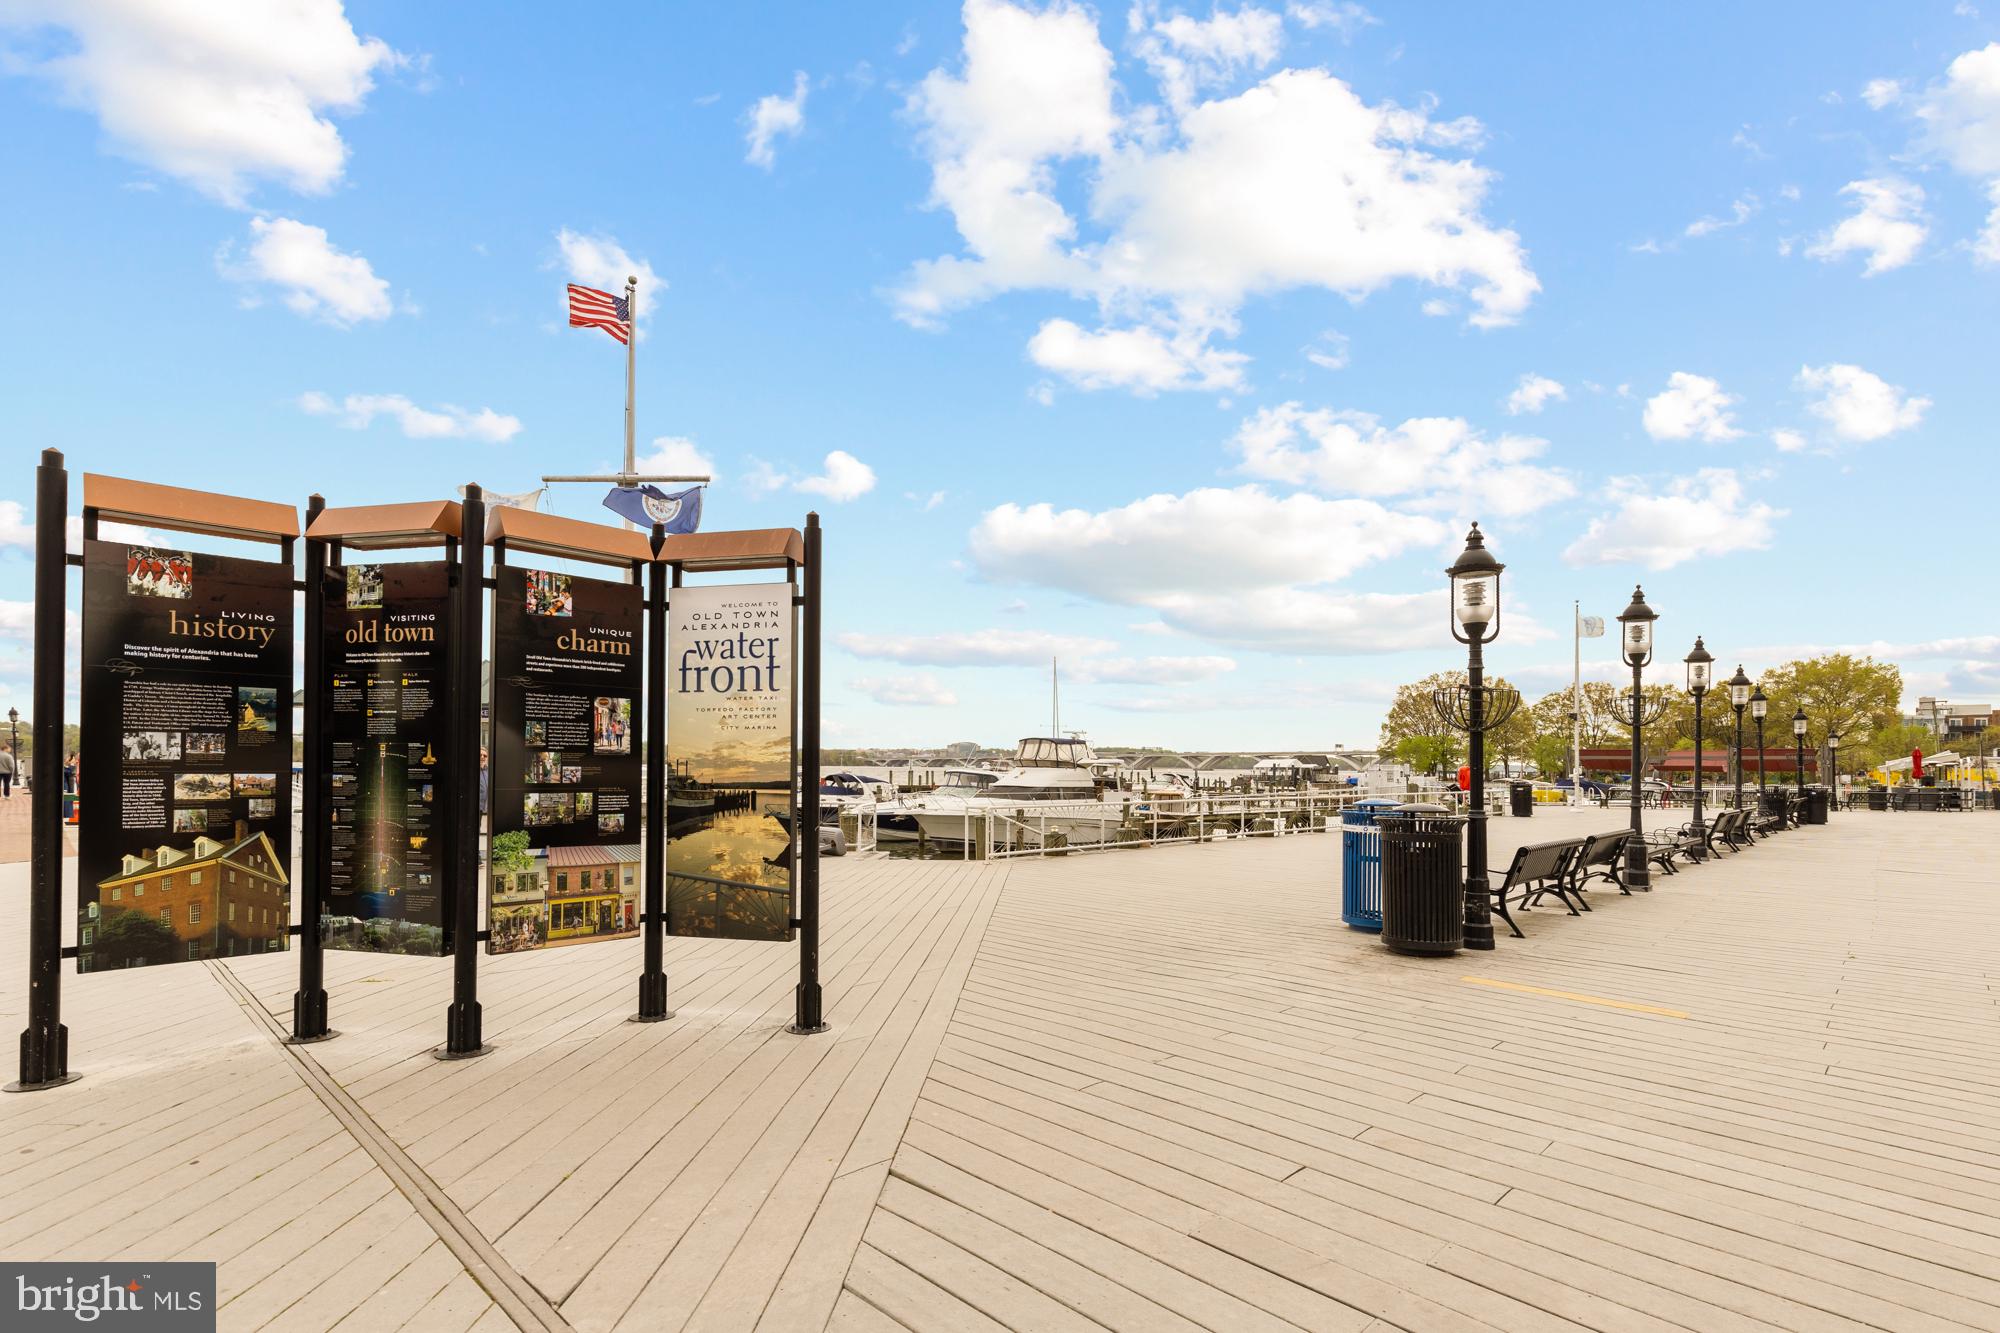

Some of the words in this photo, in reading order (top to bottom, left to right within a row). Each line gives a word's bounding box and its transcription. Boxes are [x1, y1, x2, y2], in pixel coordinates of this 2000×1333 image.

[221, 610, 276, 622] LIVING
[390, 614, 436, 622] VISITING
[692, 612, 722, 621] OLD
[733, 610, 779, 620] TOWN
[168, 610, 276, 649] history
[346, 620, 378, 644] old
[384, 623, 435, 643] town
[681, 622, 779, 631] ALEXANDRIA
[589, 627, 632, 638] UNIQUE
[556, 628, 631, 656] charm
[694, 632, 780, 660] water
[124, 650, 148, 659] making
[149, 651, 170, 660] history
[163, 647, 179, 655] spirit
[187, 648, 219, 656] Alexandria
[678, 649, 780, 693] front
